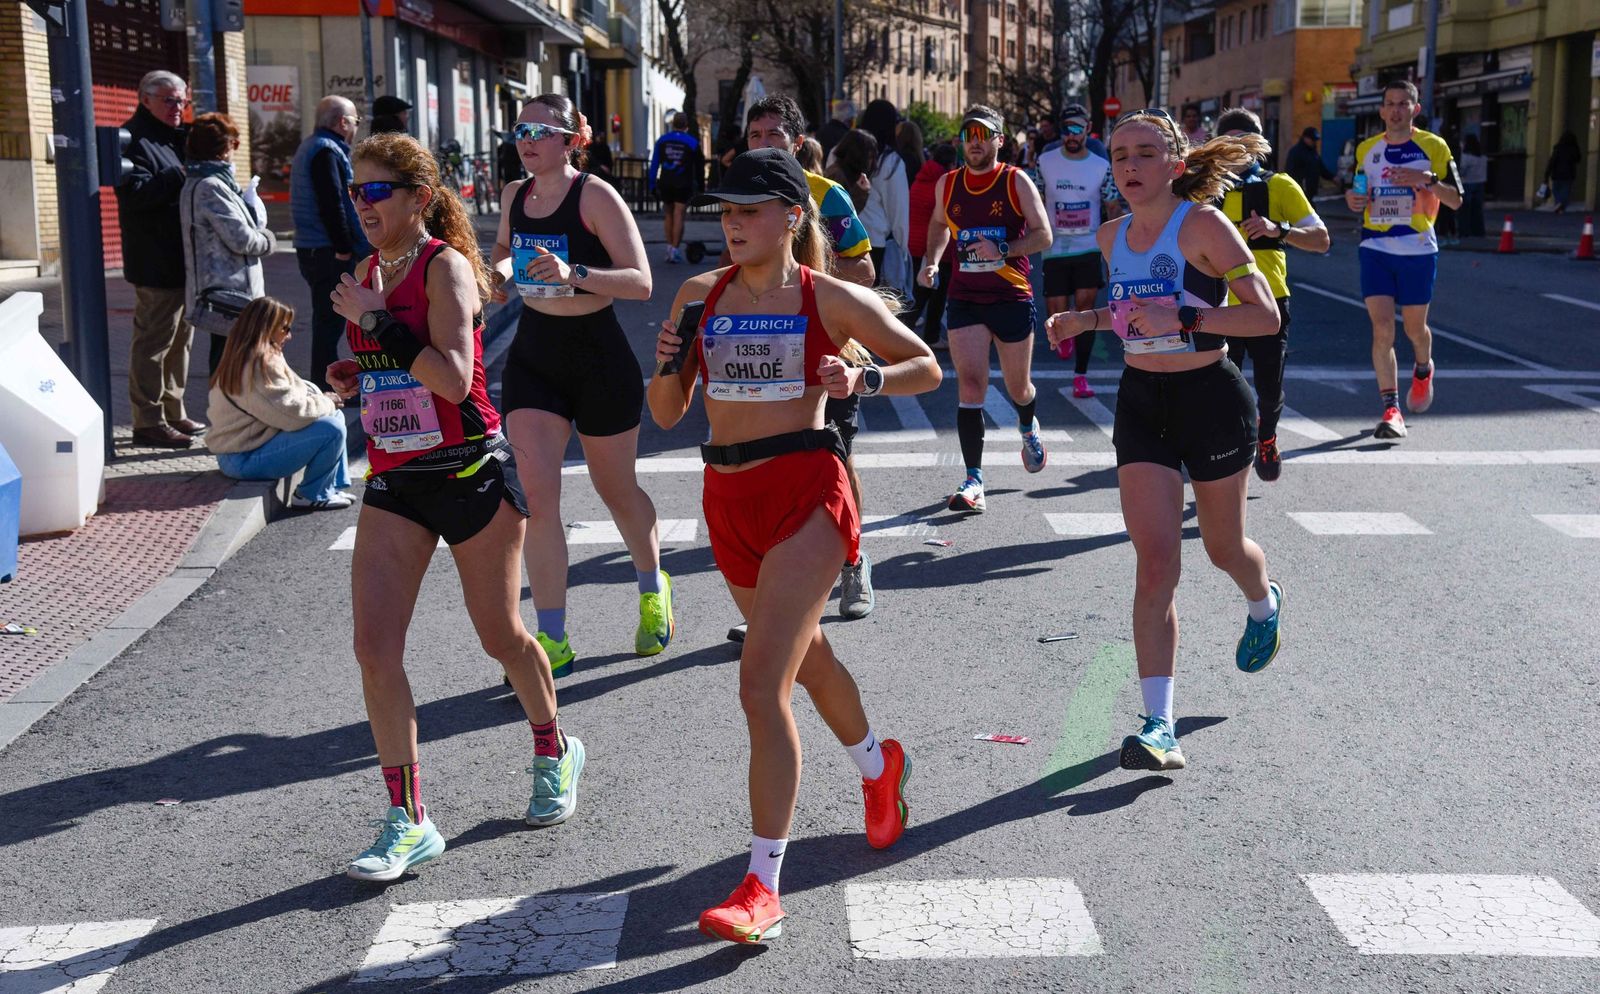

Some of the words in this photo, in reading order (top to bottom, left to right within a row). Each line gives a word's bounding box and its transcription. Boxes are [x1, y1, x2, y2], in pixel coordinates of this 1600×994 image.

[247, 84, 292, 102] OCHE
[1379, 207, 1399, 216] DANI
[525, 238, 560, 248] ZURICH
[1128, 283, 1164, 295] ZURICH
[738, 320, 793, 330] ZURICH
[735, 344, 770, 356] 13535
[725, 358, 783, 379] CHLOÉ
[380, 374, 417, 386] ZURICH
[372, 414, 421, 434] SUSAN
